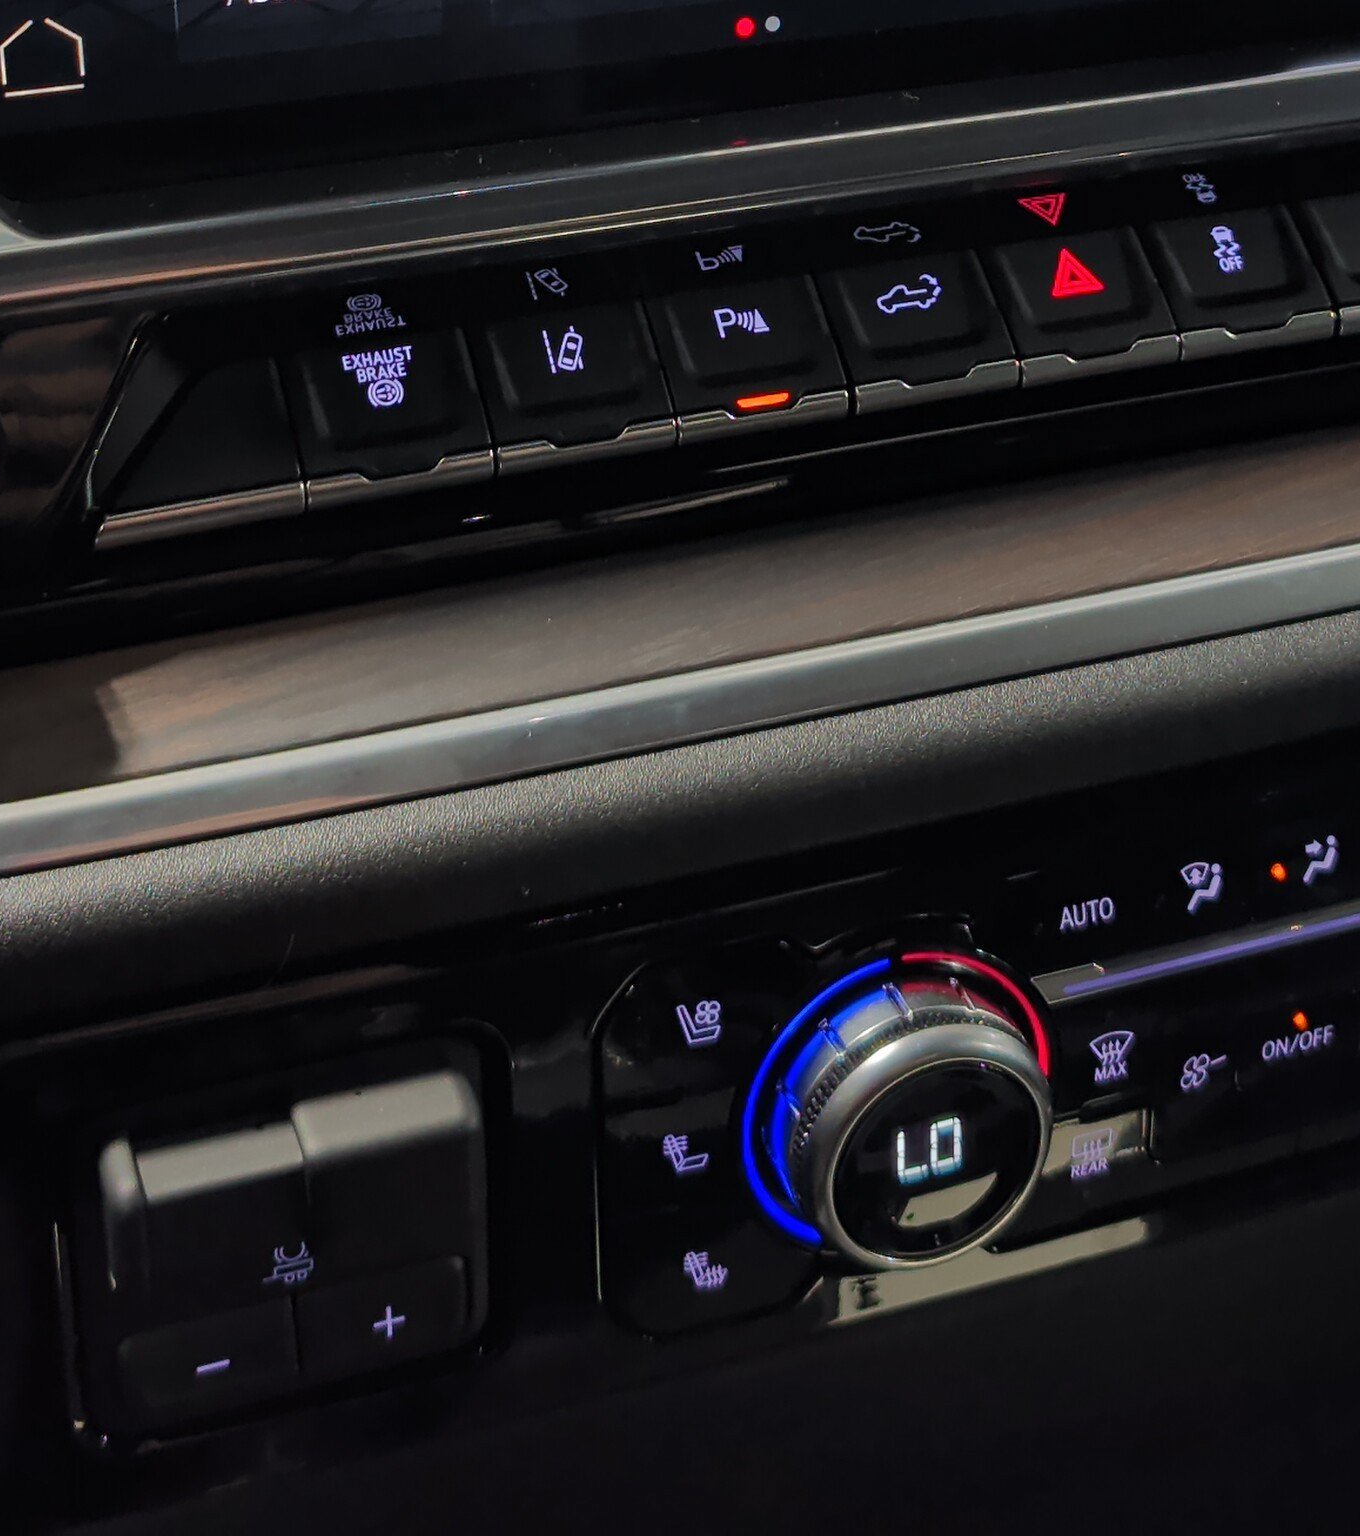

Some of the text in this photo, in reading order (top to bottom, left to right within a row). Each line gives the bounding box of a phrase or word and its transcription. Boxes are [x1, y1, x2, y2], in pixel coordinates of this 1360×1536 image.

[1219, 255, 1243, 274] OFF
[341, 345, 412, 372] EXHAUST
[356, 362, 407, 384] BRAKE
[1059, 896, 1117, 932] AUTO
[1261, 1024, 1335, 1062] ON/OFF
[1094, 1061, 1128, 1084] MAX
[1070, 1157, 1110, 1181] REAR
